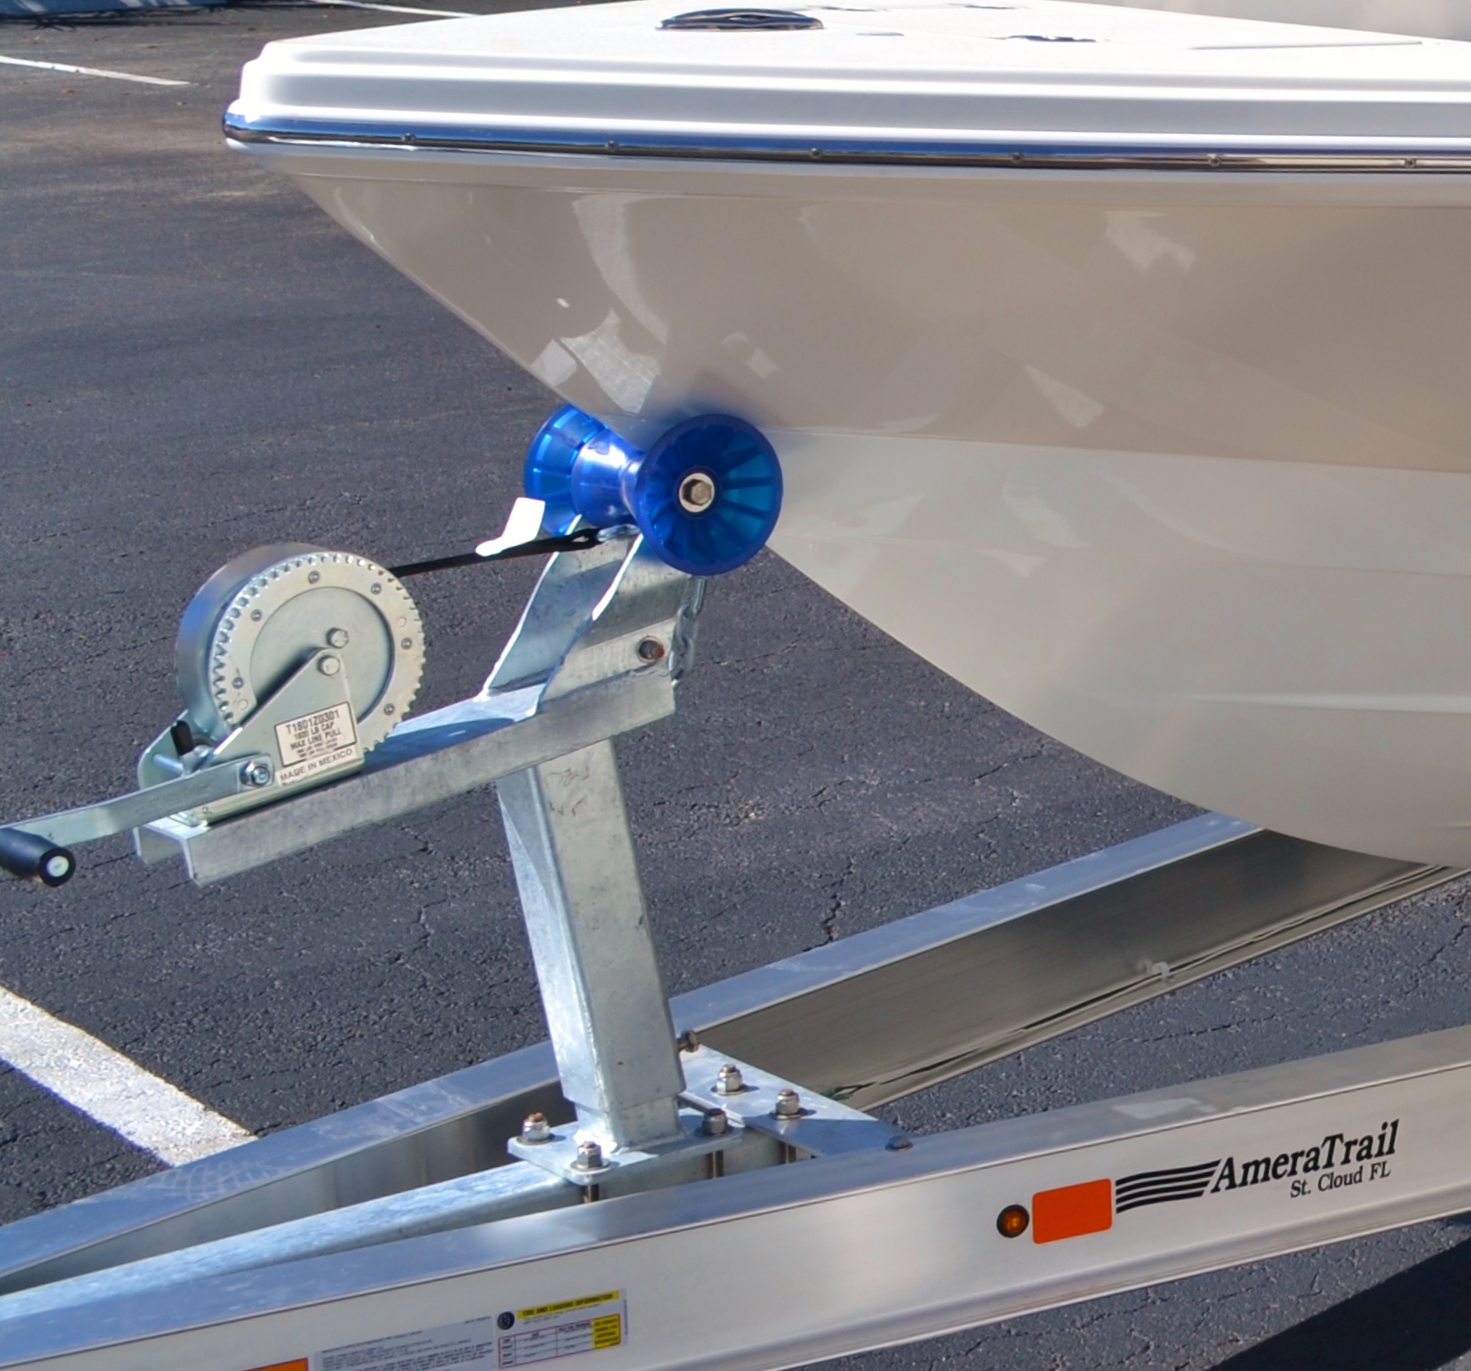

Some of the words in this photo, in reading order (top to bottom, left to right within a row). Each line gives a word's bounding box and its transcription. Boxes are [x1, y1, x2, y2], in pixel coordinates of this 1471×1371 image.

[290, 739, 306, 750] MAX
[308, 733, 322, 745] LINE
[324, 727, 342, 739] PULL
[321, 721, 334, 731] CAP
[280, 765, 306, 780] MADE
[307, 760, 317, 770] IN
[319, 747, 353, 766] MEXICO
[1209, 1118, 1400, 1194] AmeraTrail
[1290, 1180, 1311, 1198] St.
[1318, 1166, 1364, 1192] Cloud
[1369, 1161, 1391, 1181] FL
